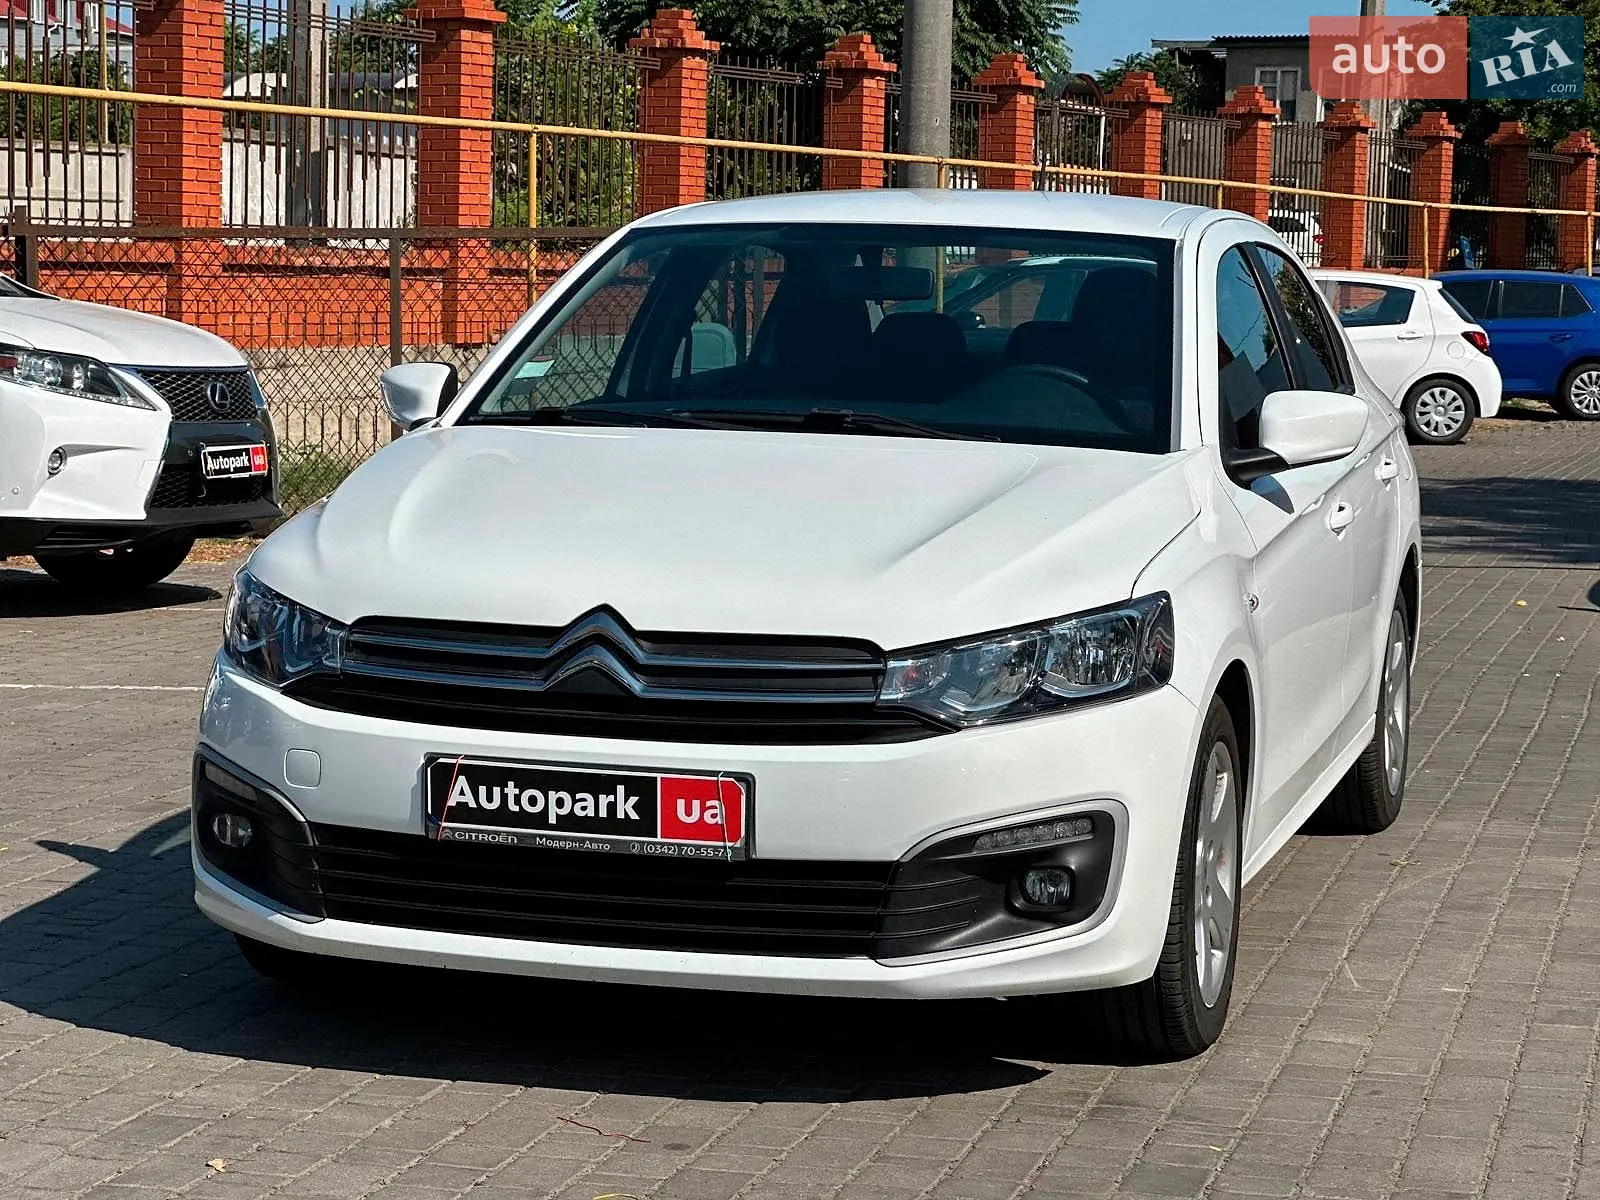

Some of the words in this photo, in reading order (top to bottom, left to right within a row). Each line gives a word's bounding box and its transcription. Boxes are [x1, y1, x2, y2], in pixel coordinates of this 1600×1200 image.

[207, 452, 249, 472] Autopark
[254, 454, 265, 465] ua
[448, 775, 641, 824] Autopark
[676, 798, 724, 825] ua
[536, 837, 611, 851] Модерн-Авто
[643, 843, 678, 856] (0342)
